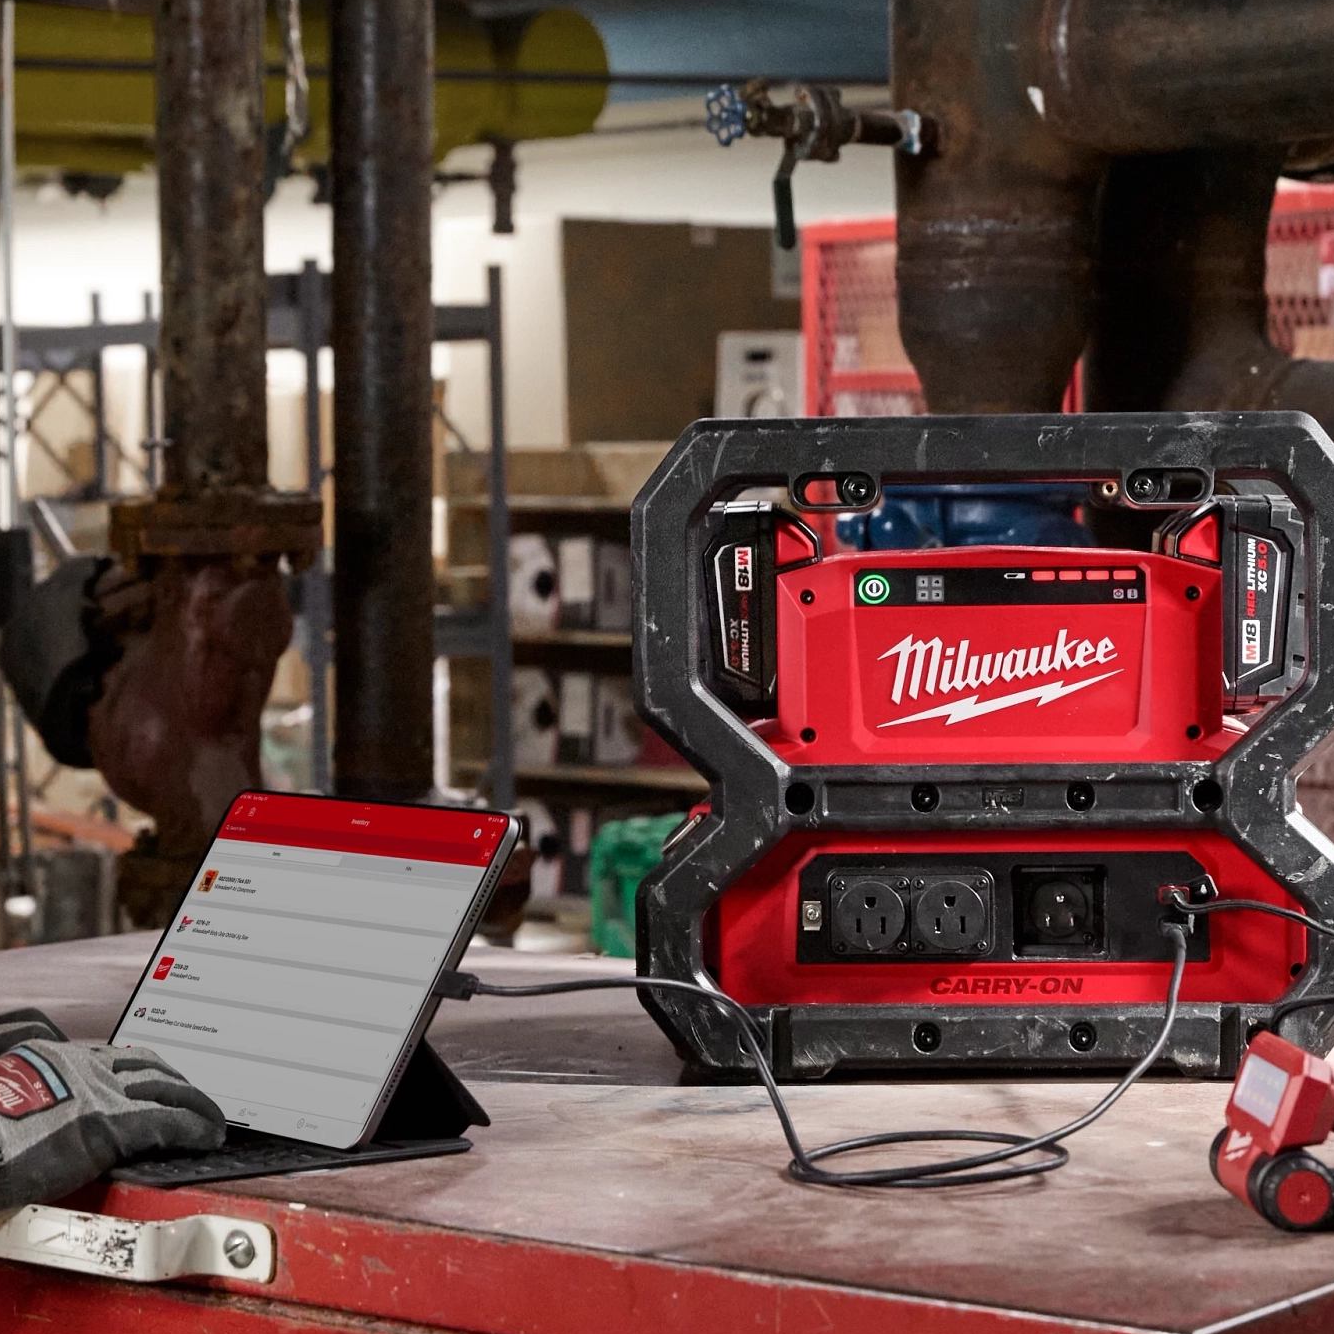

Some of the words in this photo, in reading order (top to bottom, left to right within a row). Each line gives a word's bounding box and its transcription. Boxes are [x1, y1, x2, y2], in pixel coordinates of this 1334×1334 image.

[737, 549, 750, 588] M18
[1246, 538, 1257, 617] REDLITHIUM
[1257, 542, 1268, 593] XC5.0
[1245, 622, 1257, 661] M18
[877, 629, 1118, 705] Milwaukee
[929, 977, 1084, 995] CARRY-ON
